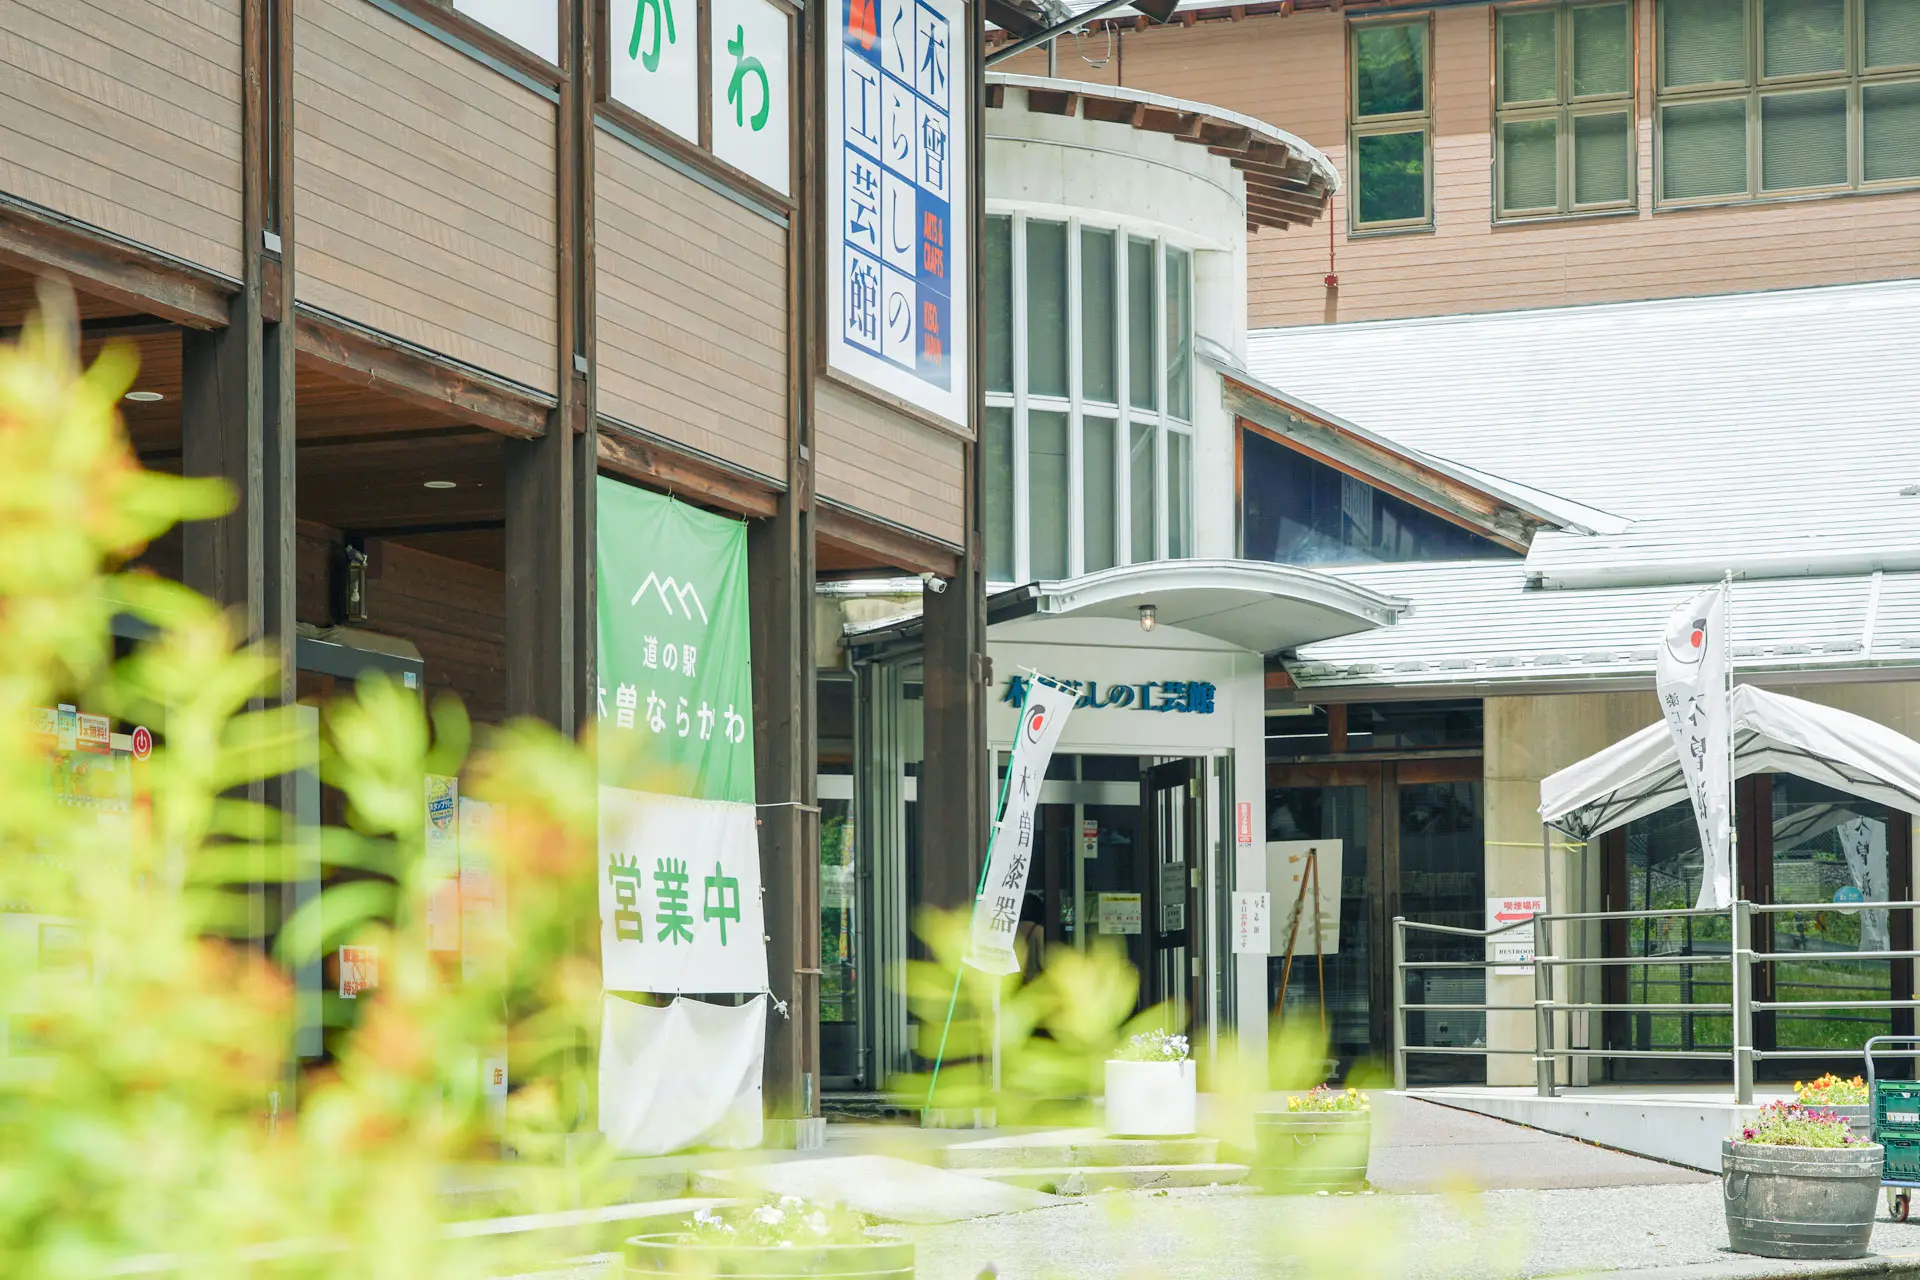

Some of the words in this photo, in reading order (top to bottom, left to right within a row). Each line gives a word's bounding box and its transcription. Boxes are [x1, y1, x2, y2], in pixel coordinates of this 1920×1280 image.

[888, 5, 912, 344] くらしの
[848, 67, 879, 342] 工芸館
[923, 210, 938, 244] ARTS
[923, 241, 944, 279] CRAFTS
[643, 634, 697, 678] 道の駅
[608, 852, 741, 947] 営業中
[1503, 900, 1541, 911] 喫煙場所
